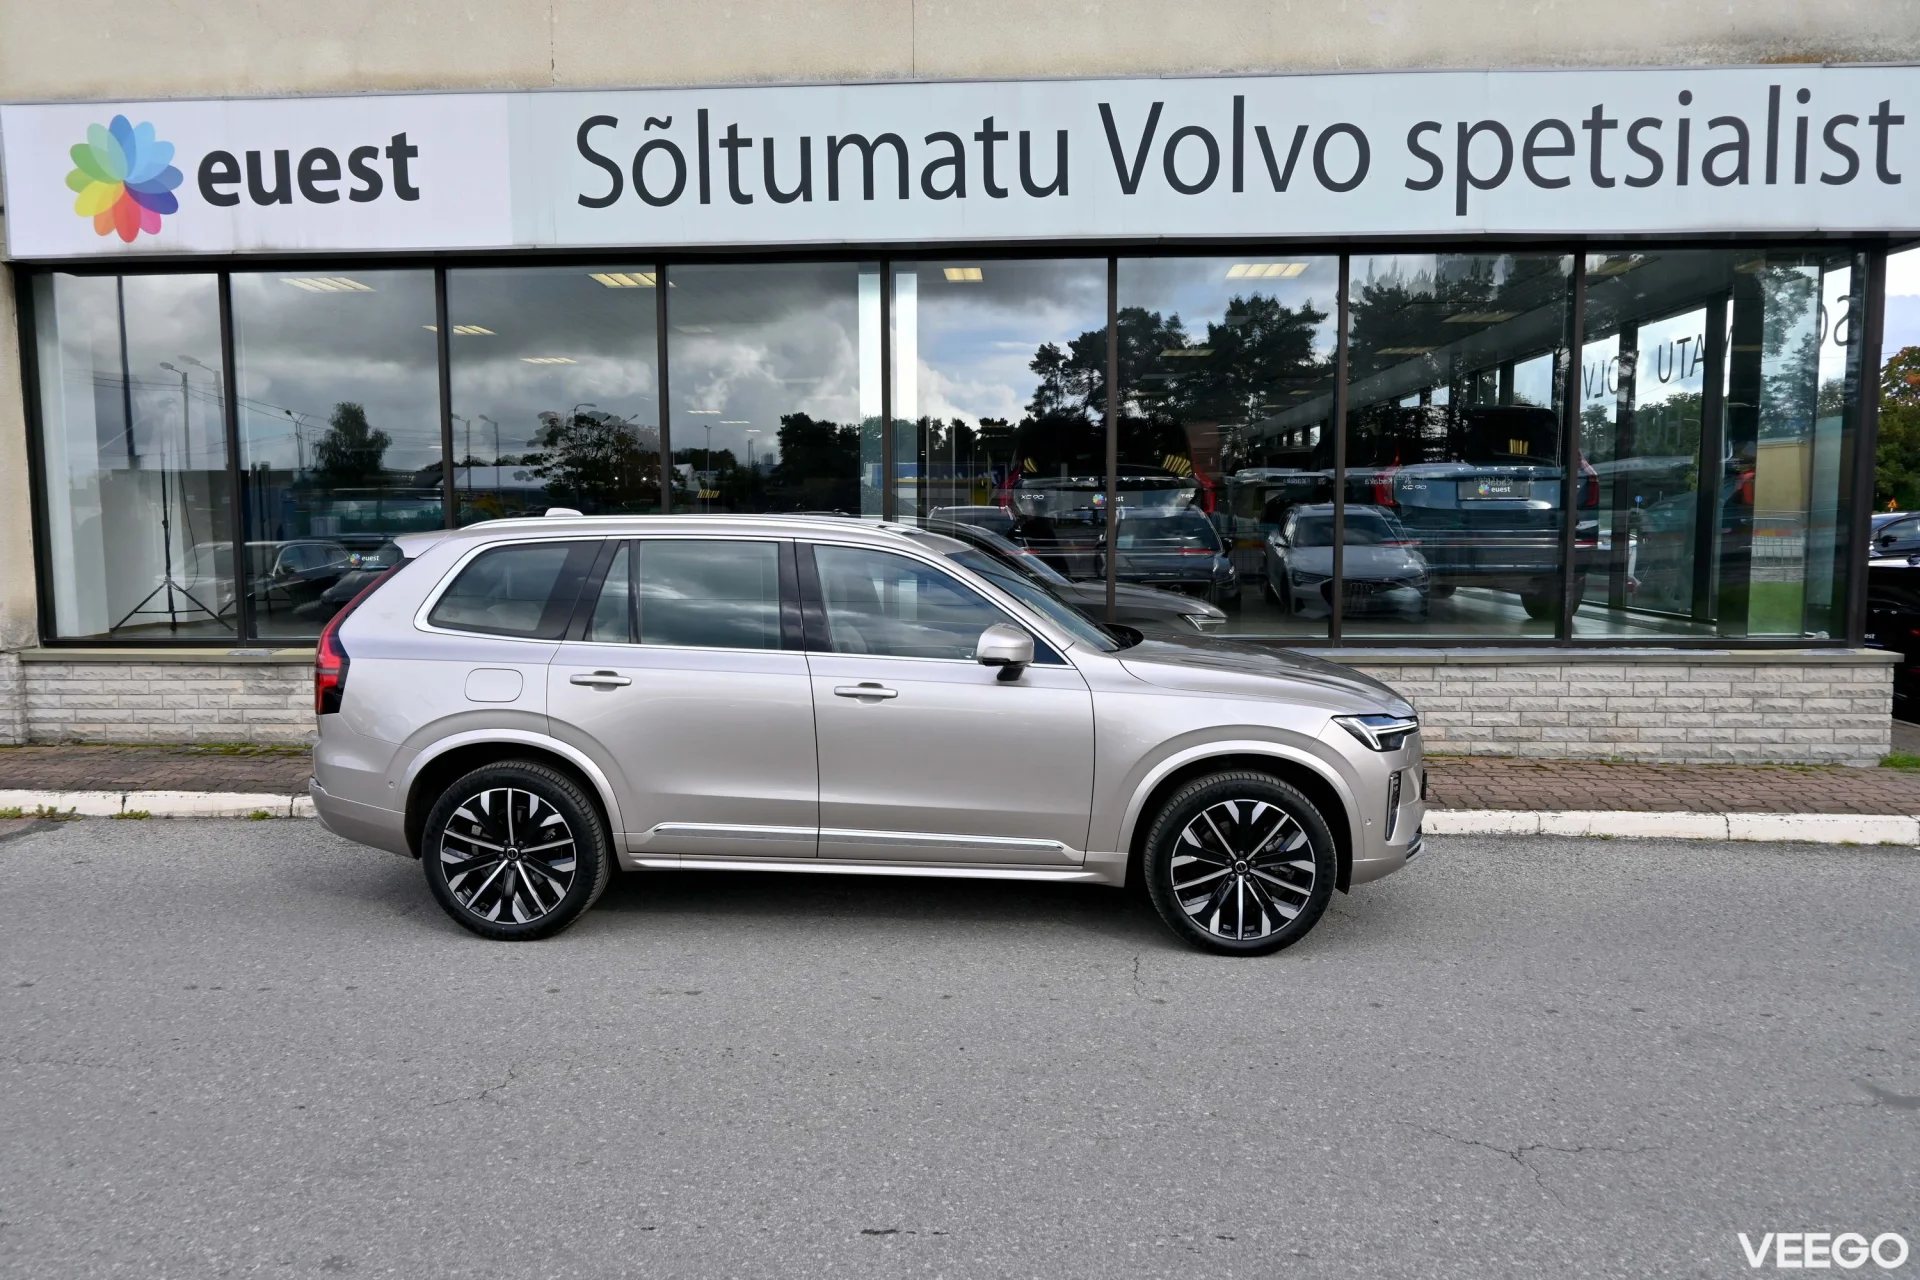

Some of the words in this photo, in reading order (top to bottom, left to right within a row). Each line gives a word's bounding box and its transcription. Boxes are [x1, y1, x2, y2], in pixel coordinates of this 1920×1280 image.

[198, 131, 419, 206] euest
[577, 109, 1069, 208] Sõltumatu
[1098, 95, 1371, 195] Volvo
[1405, 85, 1905, 216] spetsialist
[1491, 485, 1511, 493] euest
